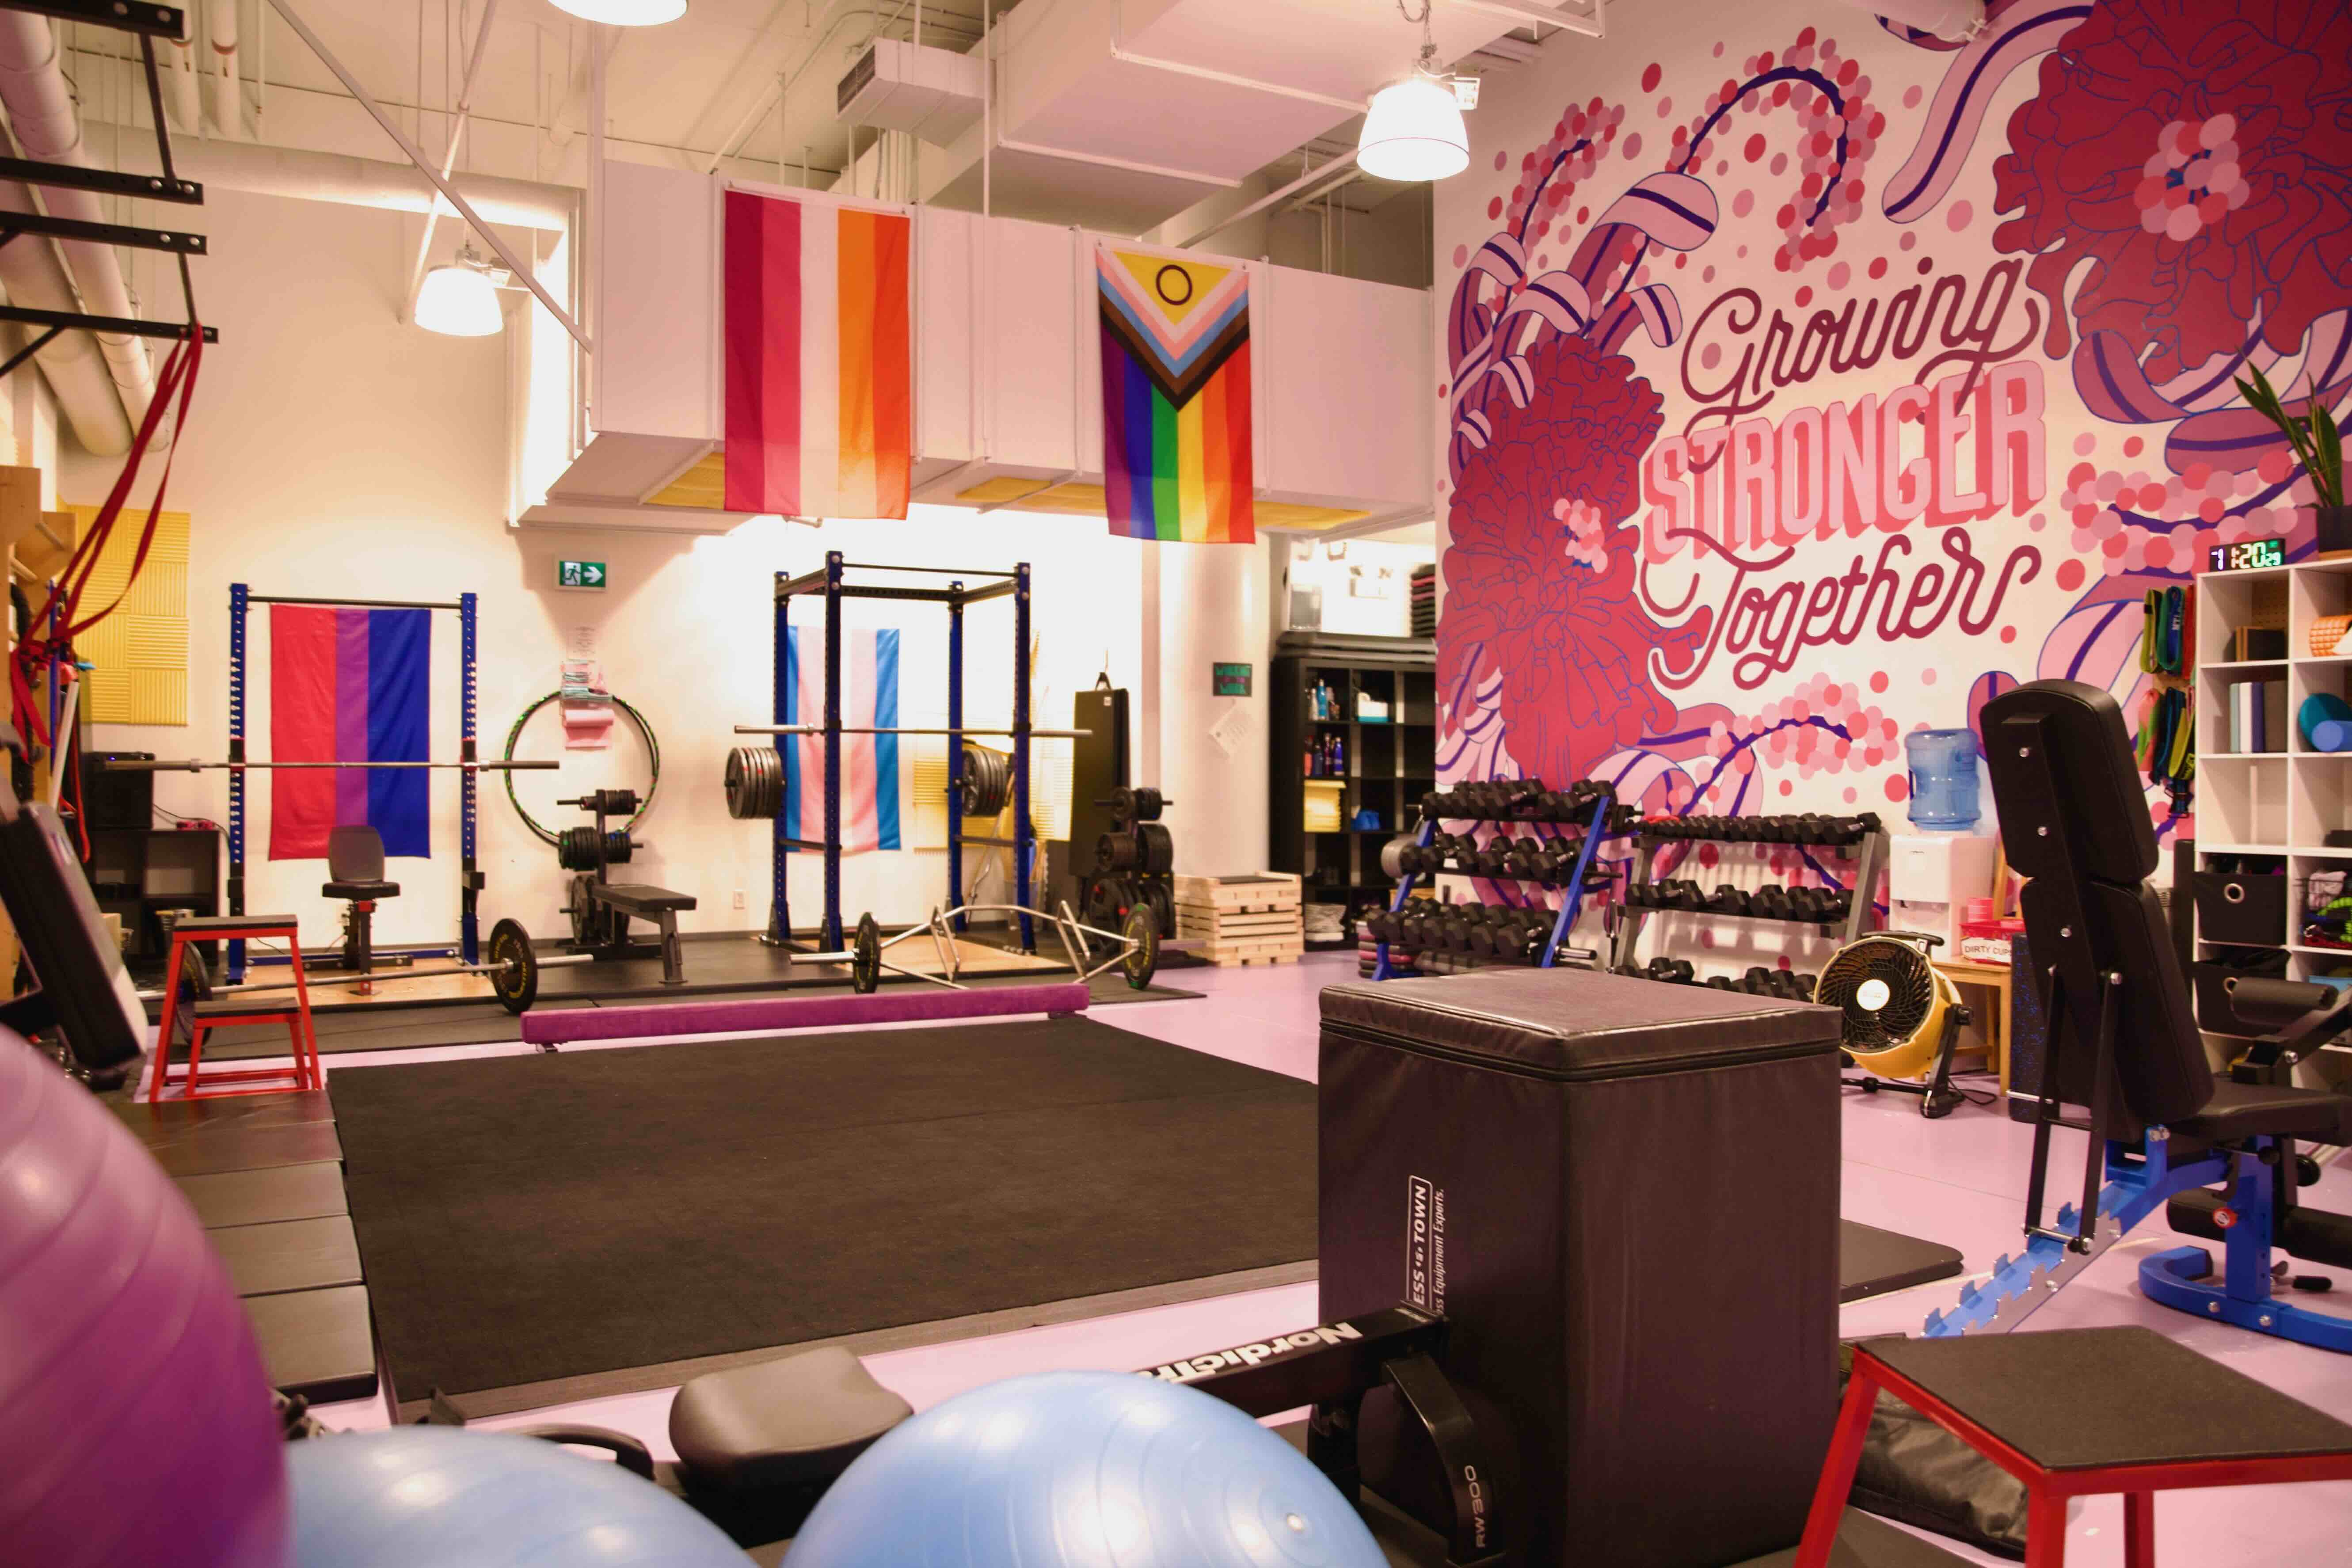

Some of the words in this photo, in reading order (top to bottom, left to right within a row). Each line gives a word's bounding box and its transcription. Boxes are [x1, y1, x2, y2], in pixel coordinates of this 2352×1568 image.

[1681, 258, 2040, 474] Growing
[1643, 360, 2047, 564] STRONGER
[1640, 526, 2042, 691] Together
[1414, 1185, 1427, 1243] TOWN
[1433, 1188, 1446, 1233] Experts.
[1433, 1235, 1446, 1295] Equipment
